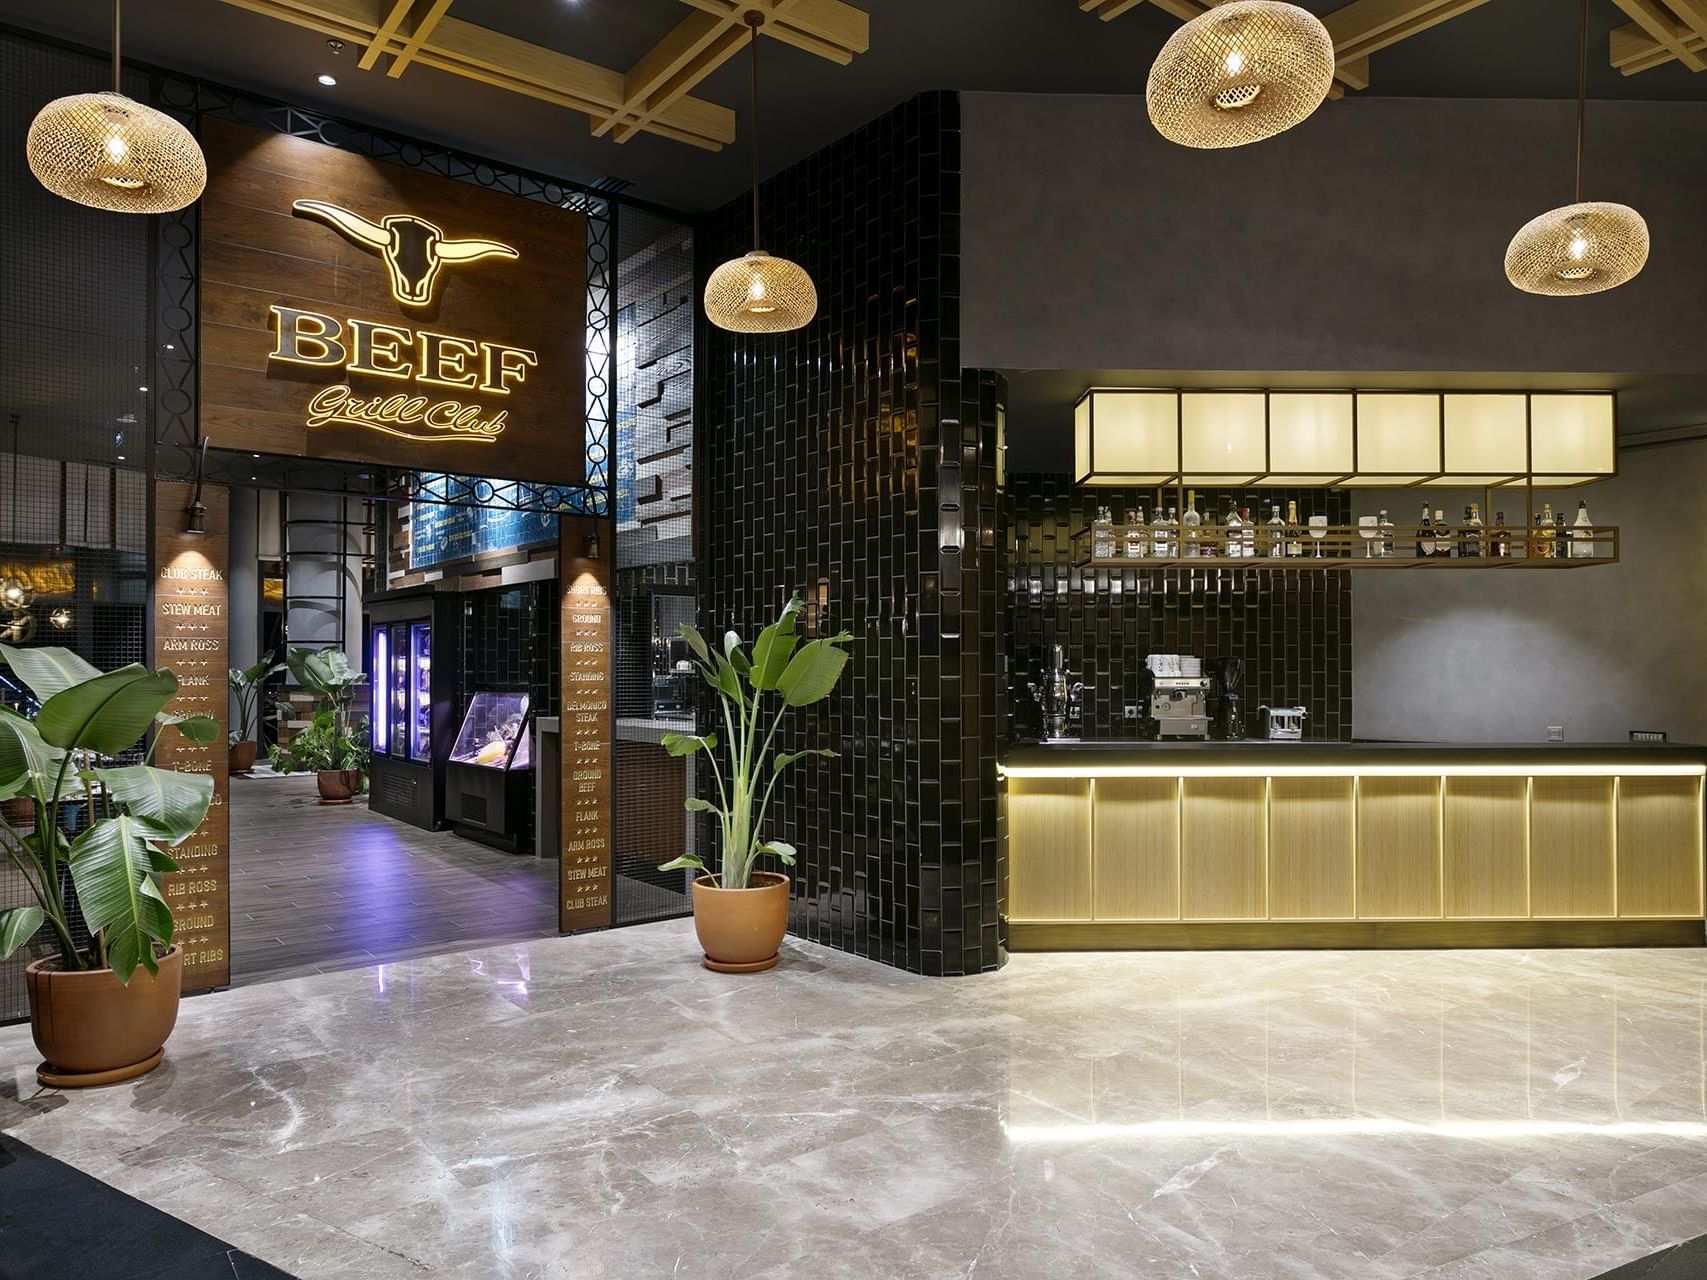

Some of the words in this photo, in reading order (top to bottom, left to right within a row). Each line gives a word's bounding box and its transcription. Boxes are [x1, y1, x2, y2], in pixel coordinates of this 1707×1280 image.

[269, 305, 538, 394] BEEF
[306, 384, 428, 427] Grill
[424, 401, 508, 435] Club
[160, 567, 188, 579] CLUB
[191, 568, 224, 581] STEAK
[162, 603, 191, 616] STEW
[193, 604, 222, 617] MEAT
[572, 613, 602, 624] GROUND
[163, 639, 188, 651] ARM
[190, 639, 219, 651] ROSS
[177, 673, 210, 686] FLANK
[569, 671, 605, 682] STANDING
[567, 700, 607, 711] DELMONICO
[575, 712, 599, 723] STEAK
[572, 769, 602, 780] GROUND
[578, 782, 596, 793] BEEF
[575, 810, 599, 822] FLANK
[167, 843, 219, 860] STANDING
[568, 840, 585, 852] ARM
[586, 838, 606, 850] ROSS
[567, 867, 587, 880] STEW
[587, 866, 607, 878] MEAT
[168, 883, 186, 896] RIB
[188, 879, 217, 894] ROSS
[566, 898, 585, 910] CLUB
[586, 895, 608, 908] STEAK
[199, 948, 224, 964] RIBS
